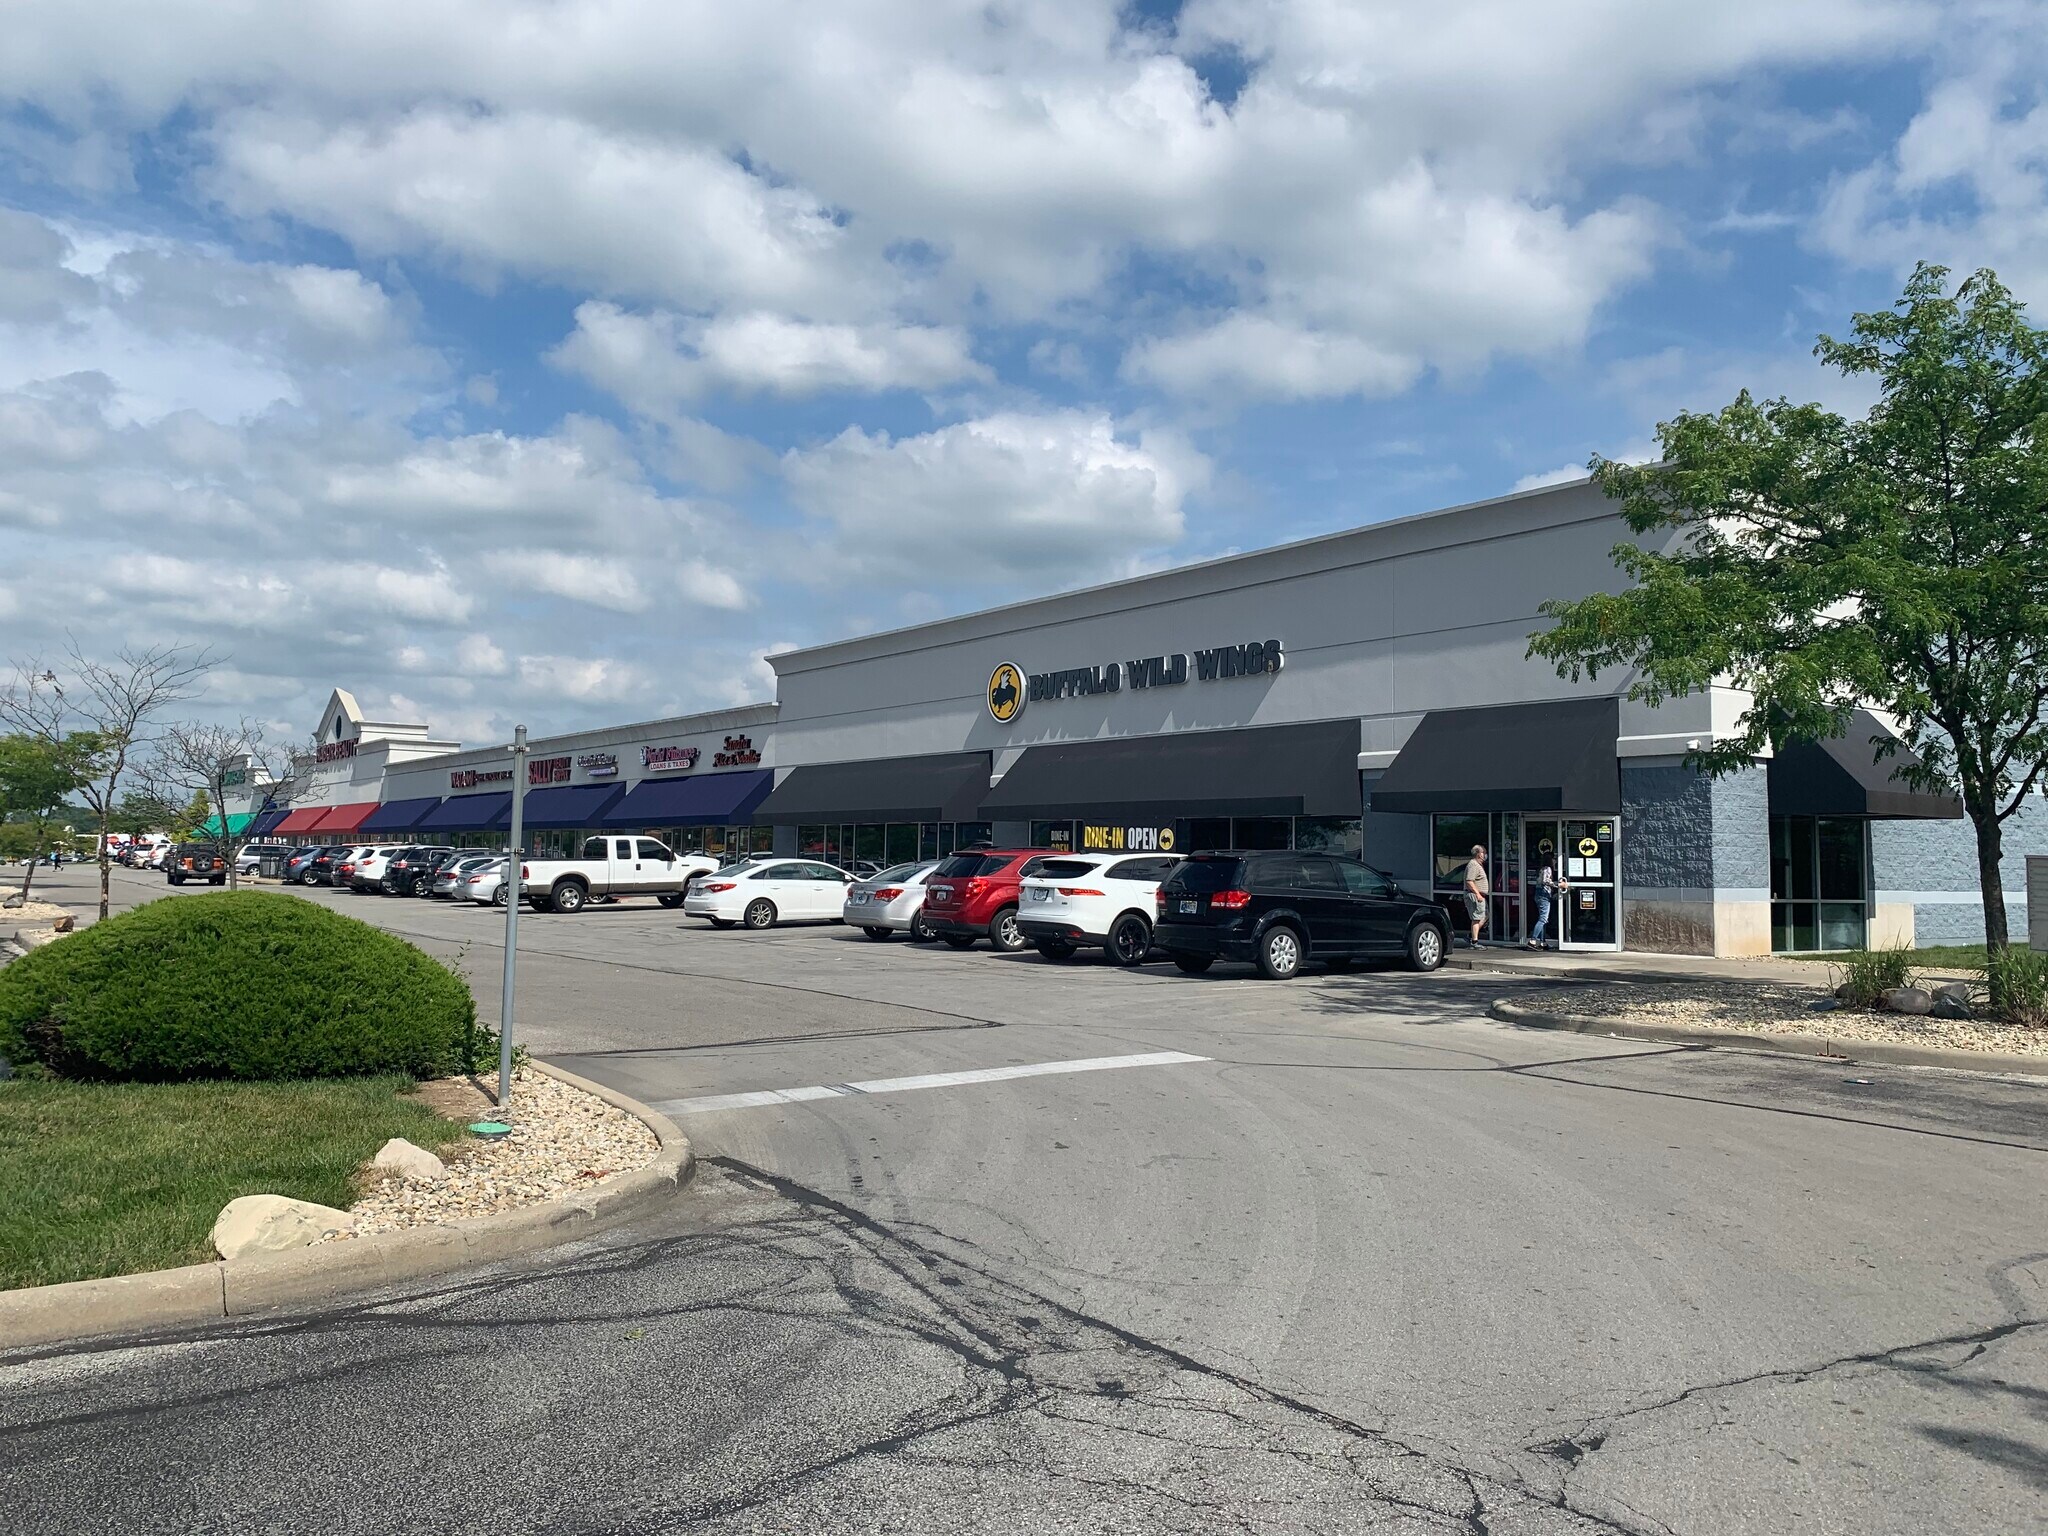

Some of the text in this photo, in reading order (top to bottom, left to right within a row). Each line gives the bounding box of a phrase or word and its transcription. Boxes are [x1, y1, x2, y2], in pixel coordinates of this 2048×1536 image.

[1029, 639, 1285, 701] BUFFALO WILD WINGS
[528, 759, 554, 785] SALLY
[553, 757, 572, 769] BEAUTY
[1051, 830, 1069, 840] DINE-IN
[1084, 826, 1157, 850] DINE-IN OPEN
